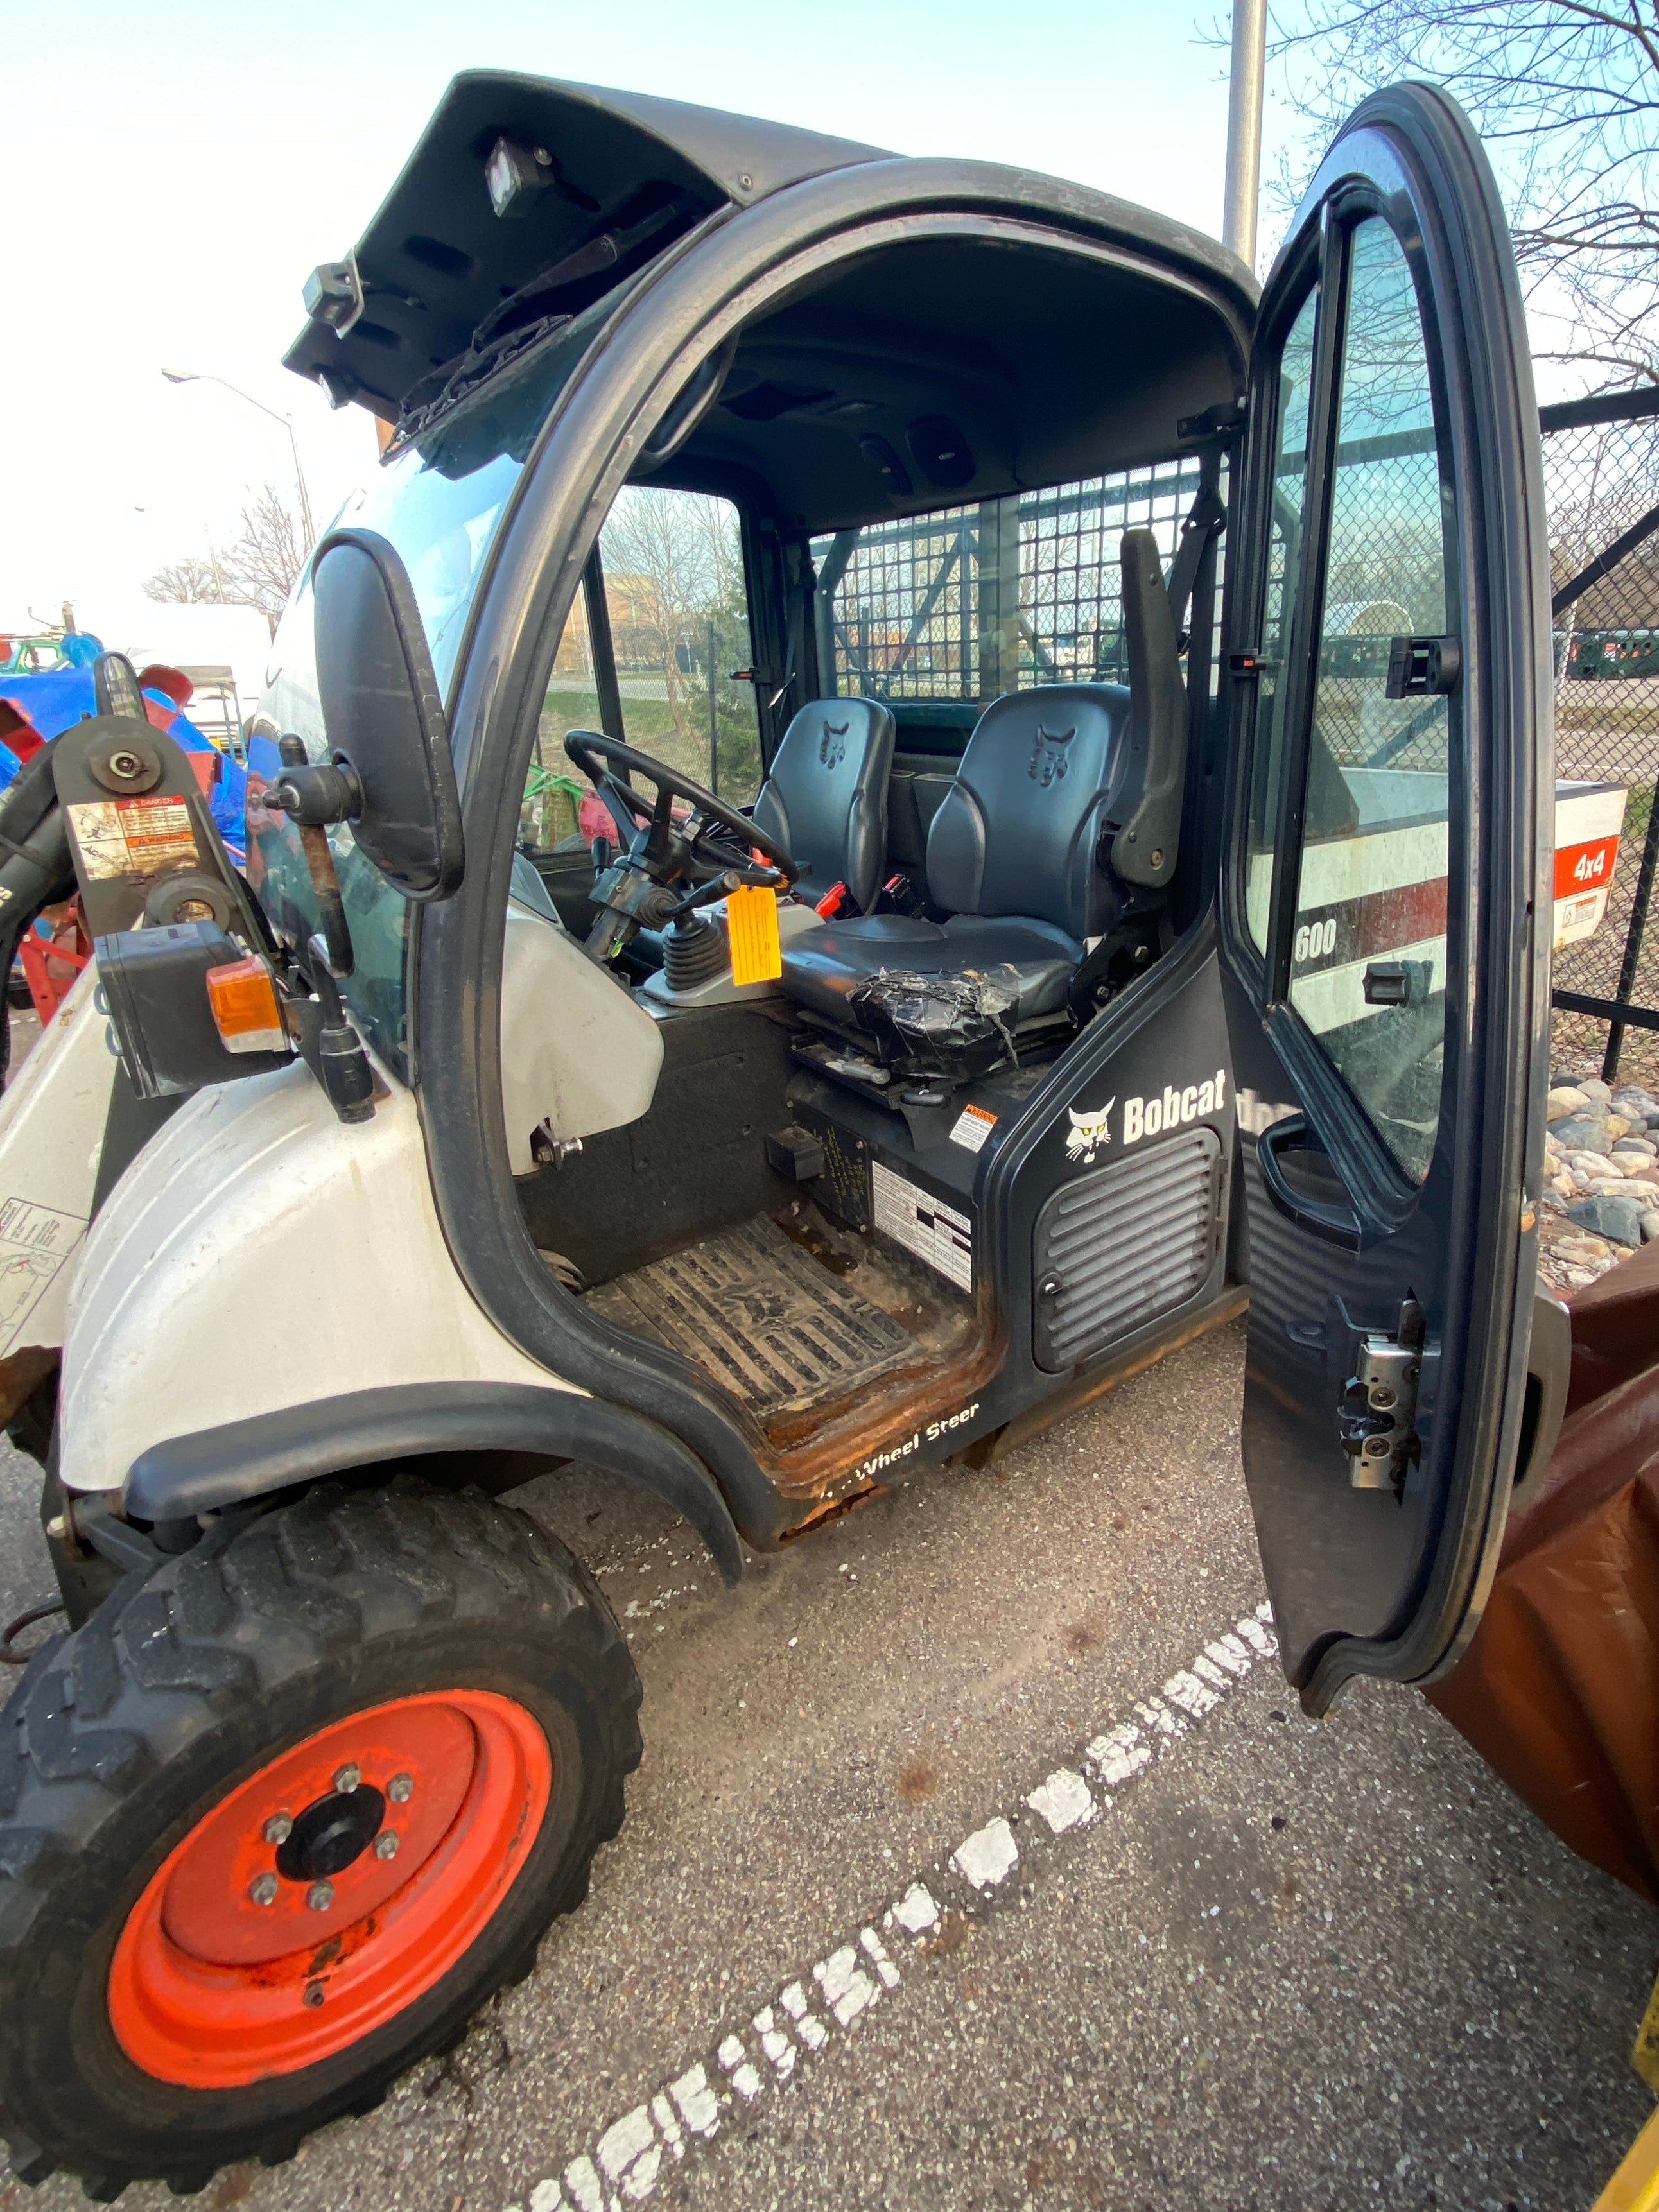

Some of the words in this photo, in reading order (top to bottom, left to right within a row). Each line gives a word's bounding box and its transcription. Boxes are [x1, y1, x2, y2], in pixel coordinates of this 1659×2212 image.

[1574, 849, 1606, 881] 4x4
[1124, 1069, 1226, 1145] Bobcat
[926, 1403, 980, 1442] Steer
